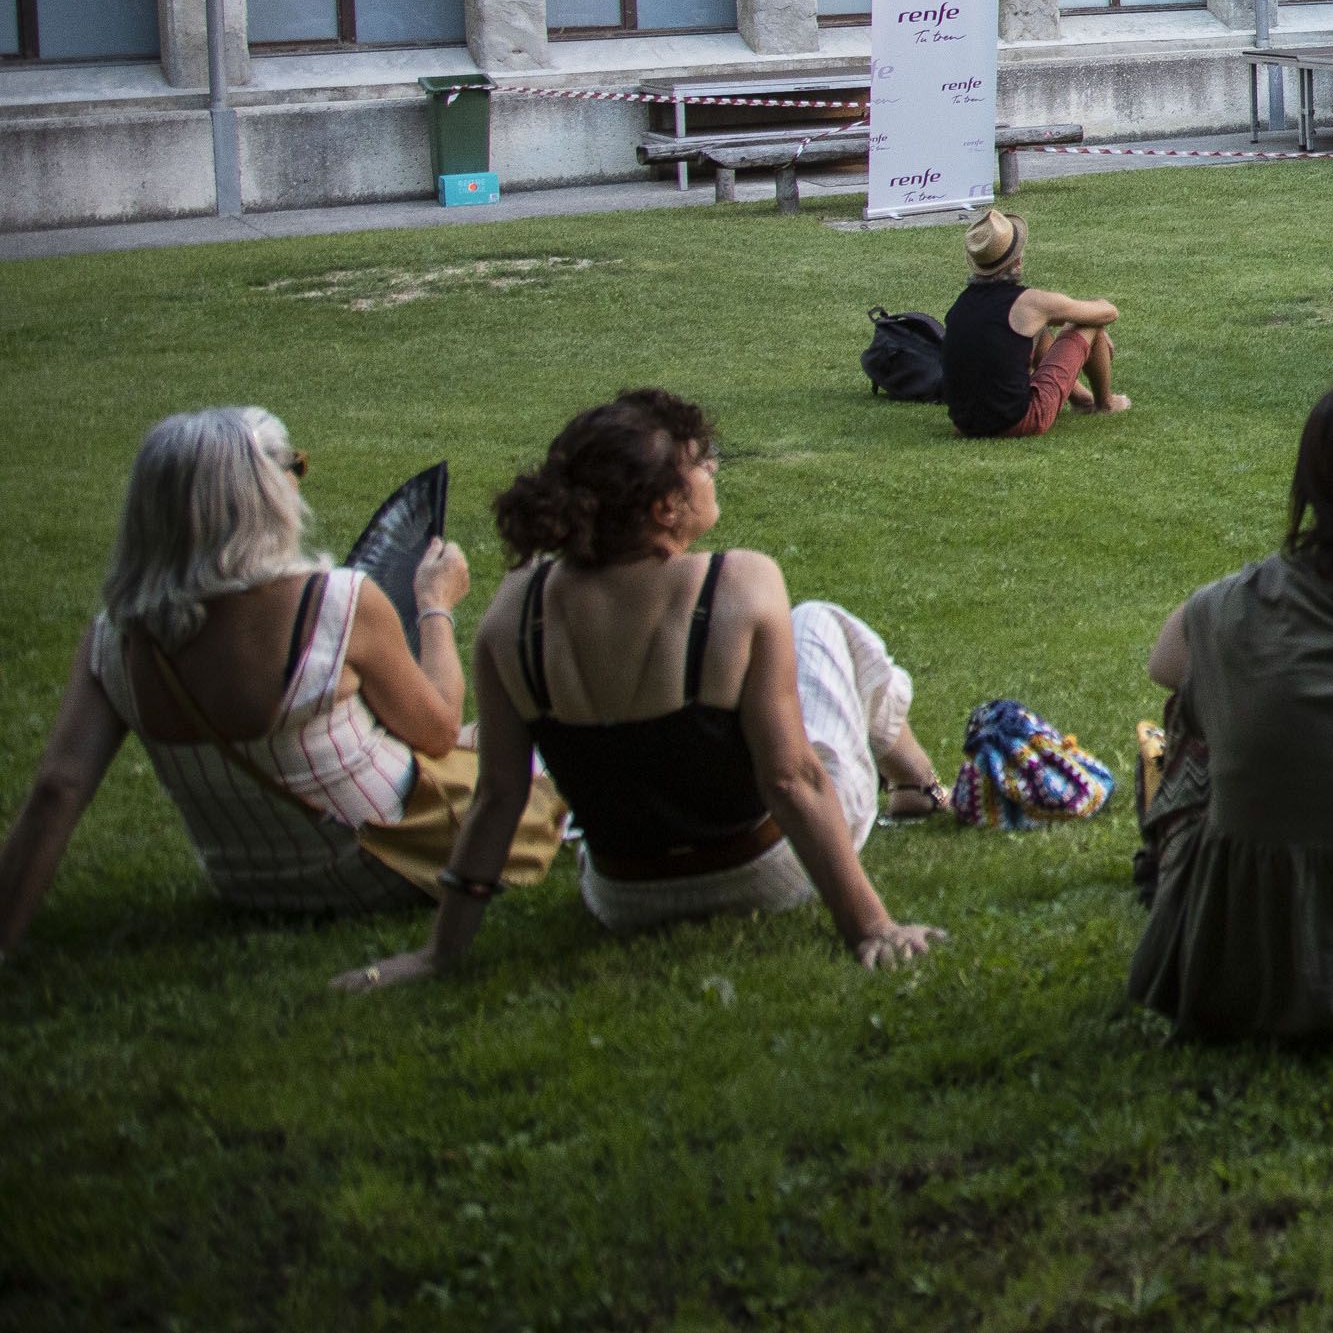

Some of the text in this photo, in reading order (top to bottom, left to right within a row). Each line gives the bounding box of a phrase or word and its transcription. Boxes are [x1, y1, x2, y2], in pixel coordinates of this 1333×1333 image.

[898, 1, 960, 27] renfe
[913, 29, 968, 44] Tu tren
[941, 76, 982, 93] renfe
[889, 167, 941, 188] renfe
[903, 191, 946, 203] Tu tren
